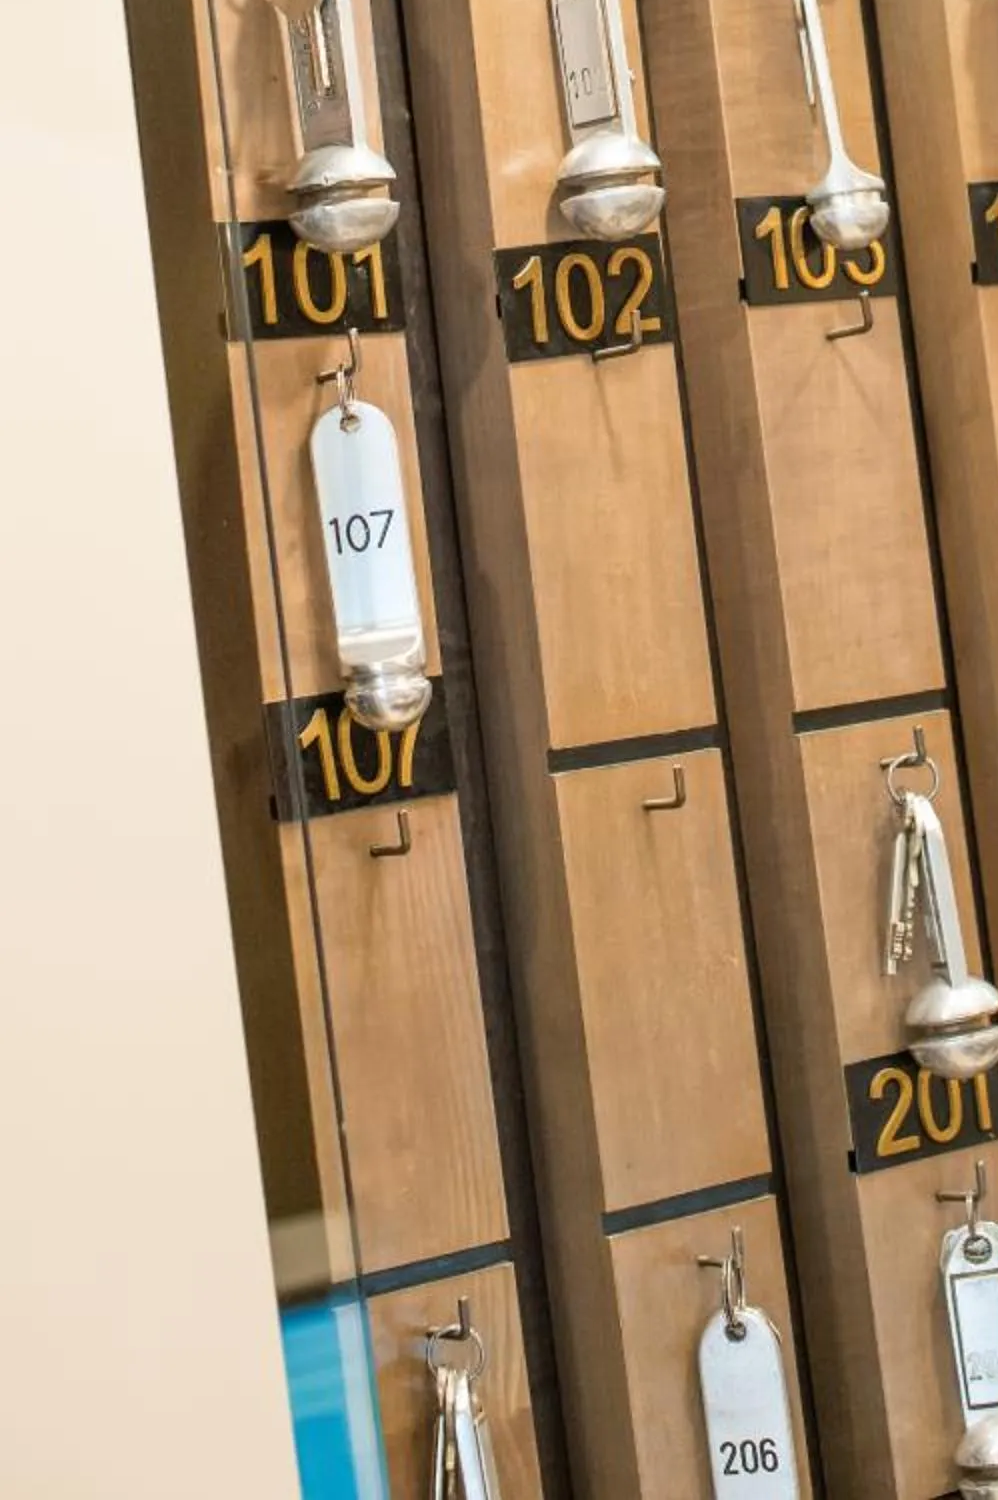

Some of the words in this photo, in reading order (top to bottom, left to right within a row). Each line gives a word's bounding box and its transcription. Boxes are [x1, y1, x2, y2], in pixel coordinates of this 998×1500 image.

[243, 233, 388, 324] 101
[512, 247, 661, 343] 102
[328, 508, 395, 555] 107
[719, 1437, 779, 1476] 206
